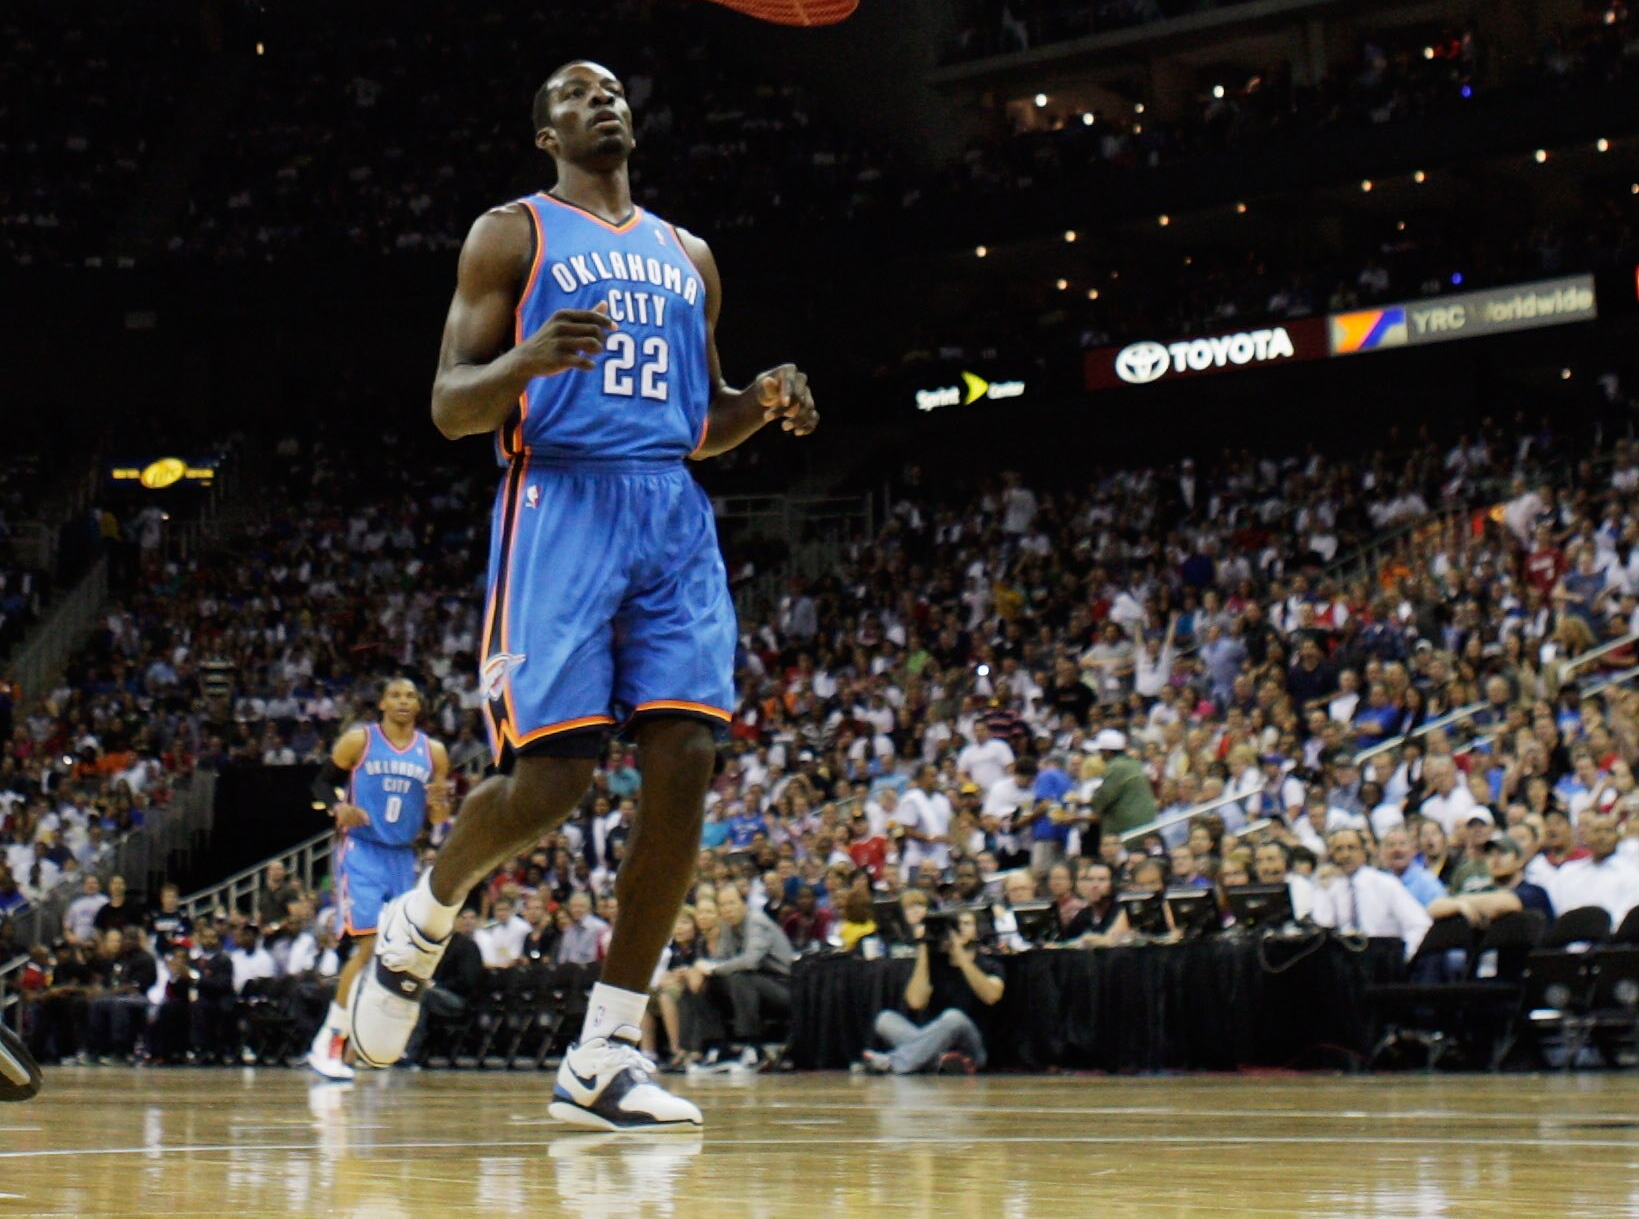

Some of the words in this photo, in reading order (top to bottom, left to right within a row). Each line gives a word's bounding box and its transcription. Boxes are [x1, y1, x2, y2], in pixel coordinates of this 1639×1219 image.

[551, 250, 698, 306] OKLAHOMA
[608, 289, 666, 327] CITY
[1413, 306, 1466, 334] YRC
[1169, 326, 1295, 373] TOYOTA
[603, 332, 668, 401] 22
[365, 760, 429, 783] OKLAHOMA
[384, 777, 411, 794] CITY
[386, 796, 402, 823] 0
